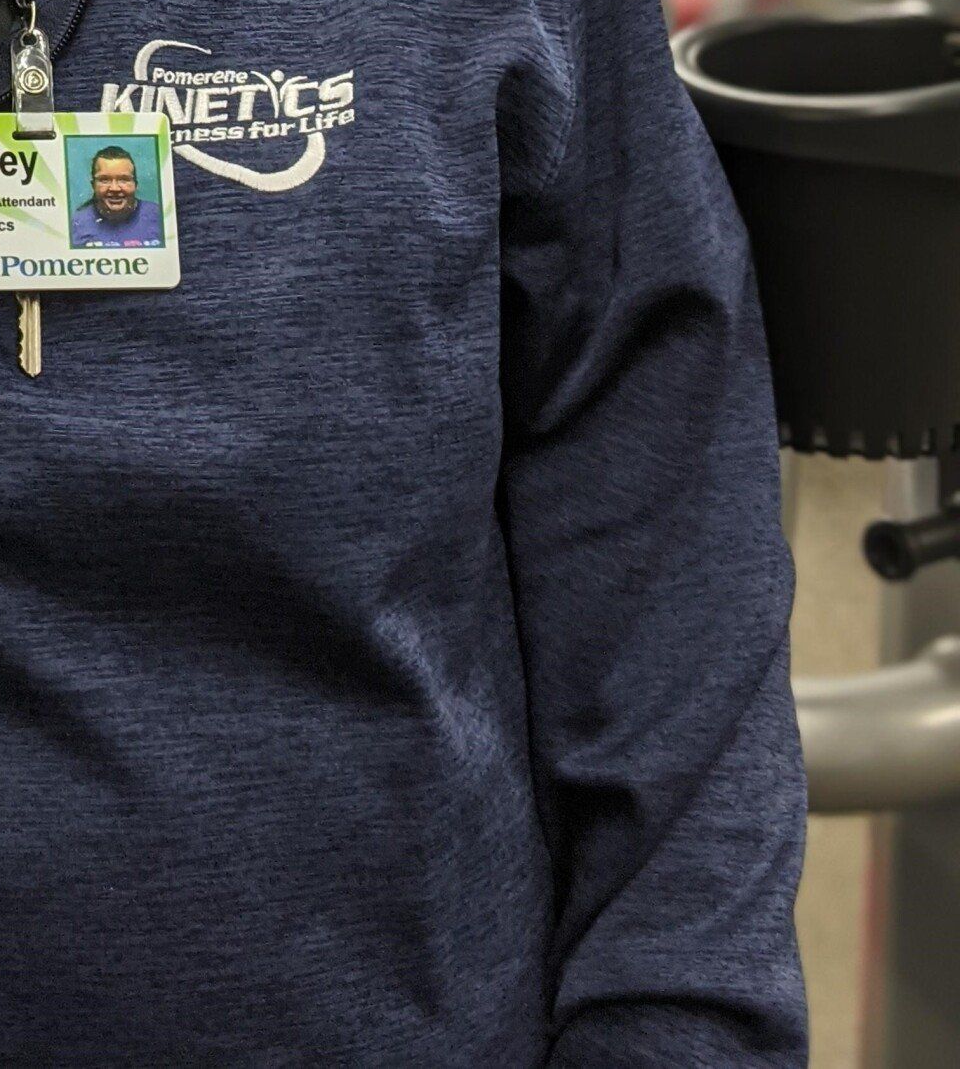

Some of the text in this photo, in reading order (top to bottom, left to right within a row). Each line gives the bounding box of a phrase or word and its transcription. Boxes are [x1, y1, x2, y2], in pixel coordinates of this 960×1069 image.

[152, 66, 249, 85] Pomerene
[100, 69, 354, 125] KINETICS
[171, 108, 355, 143] ness for Life
[1, 255, 149, 276] Pomerene
